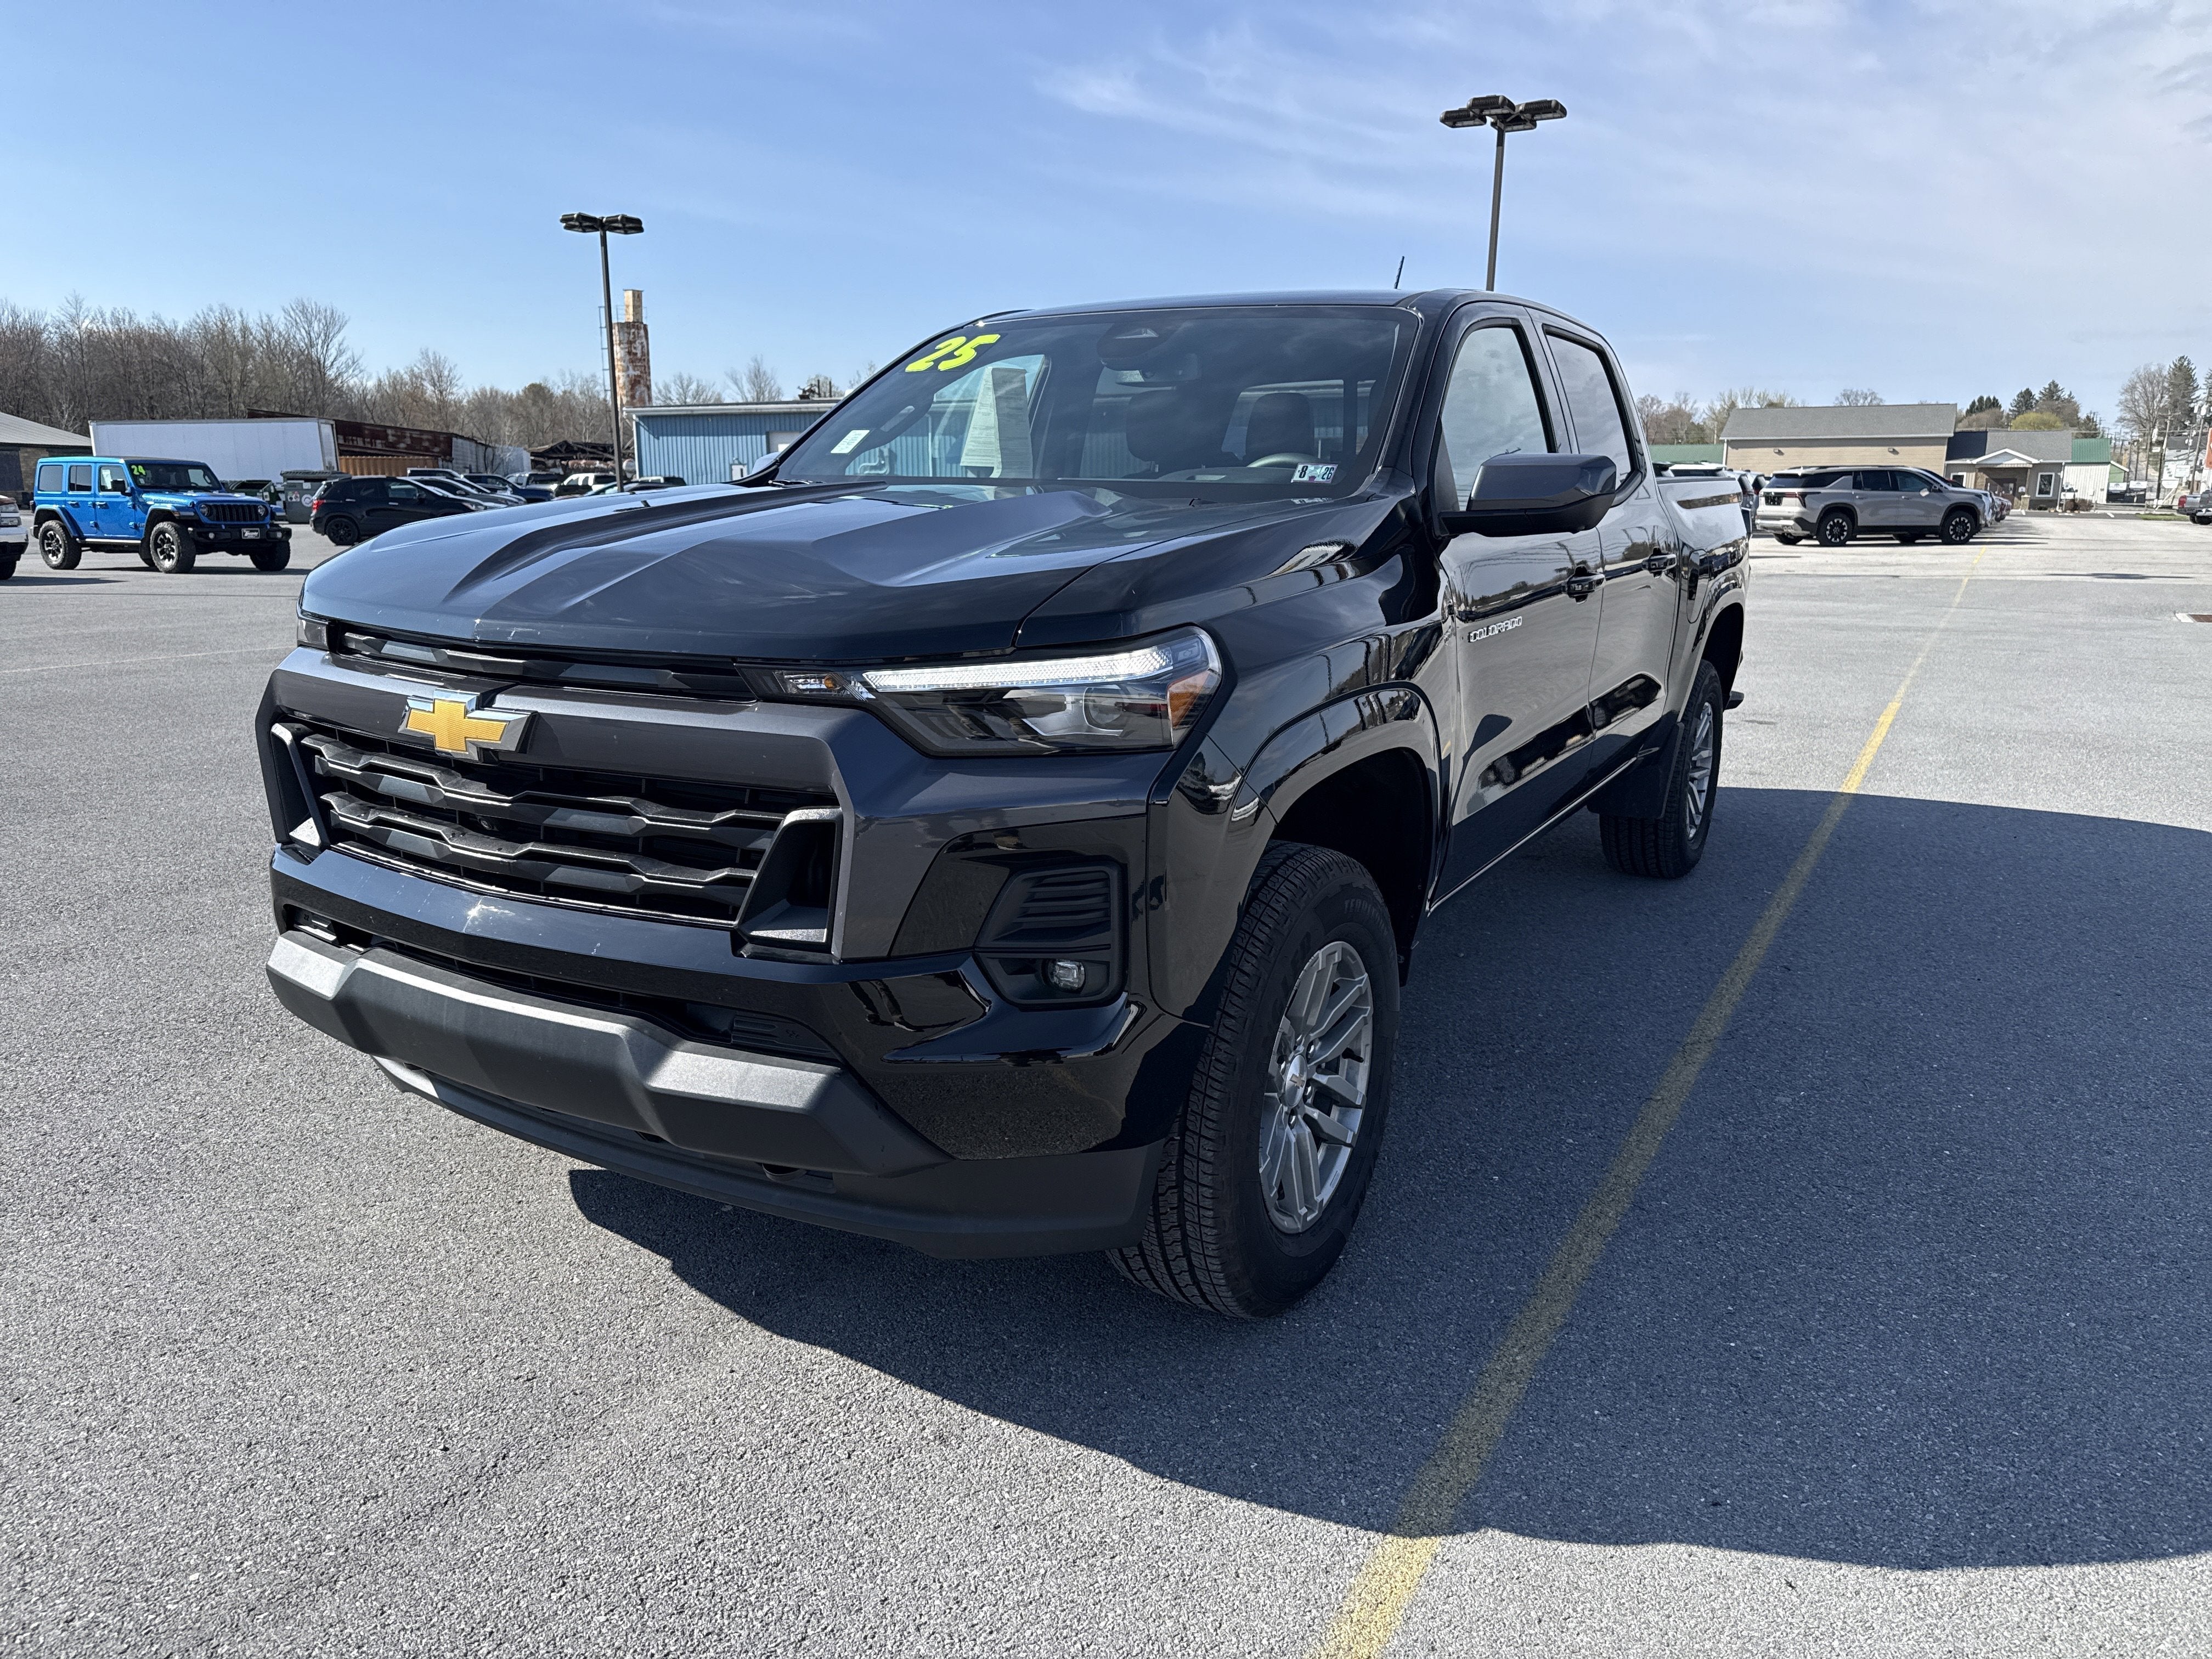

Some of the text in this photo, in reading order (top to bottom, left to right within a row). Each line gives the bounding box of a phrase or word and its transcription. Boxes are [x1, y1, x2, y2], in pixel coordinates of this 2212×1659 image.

[905, 334, 1001, 373] 25
[131, 464, 146, 476] 24
[1298, 465, 1335, 480] 8 26
[1468, 616, 1522, 643] COLORADO
